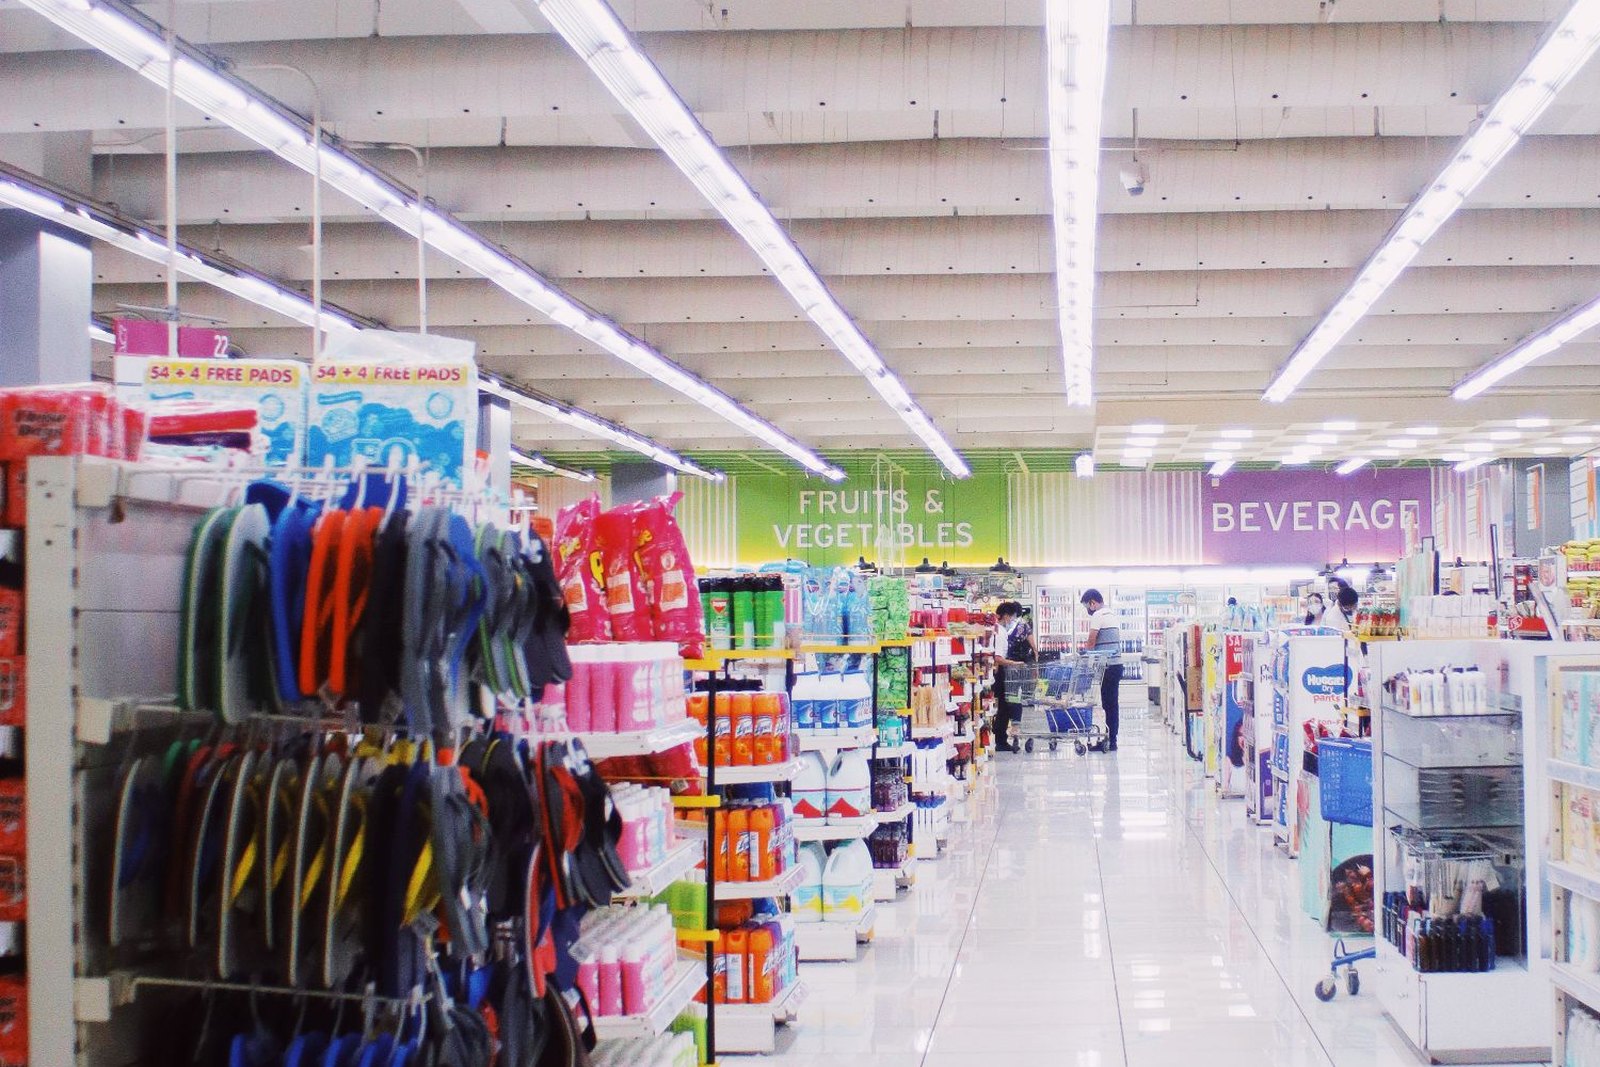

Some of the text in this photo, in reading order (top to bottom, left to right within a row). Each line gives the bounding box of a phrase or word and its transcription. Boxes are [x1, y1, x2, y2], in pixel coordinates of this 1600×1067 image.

[214, 334, 229, 358] 22
[151, 366, 170, 379] 54
[190, 367, 200, 380] 4
[207, 367, 243, 381] FREE
[249, 369, 293, 383] PADS
[317, 366, 337, 378] 54
[357, 366, 367, 378] 4
[374, 366, 411, 380] FREE
[417, 367, 461, 381] PADS
[799, 489, 944, 515] FRUITS &
[772, 522, 974, 549] VEGETABLES
[1313, 694, 1341, 704] pants
